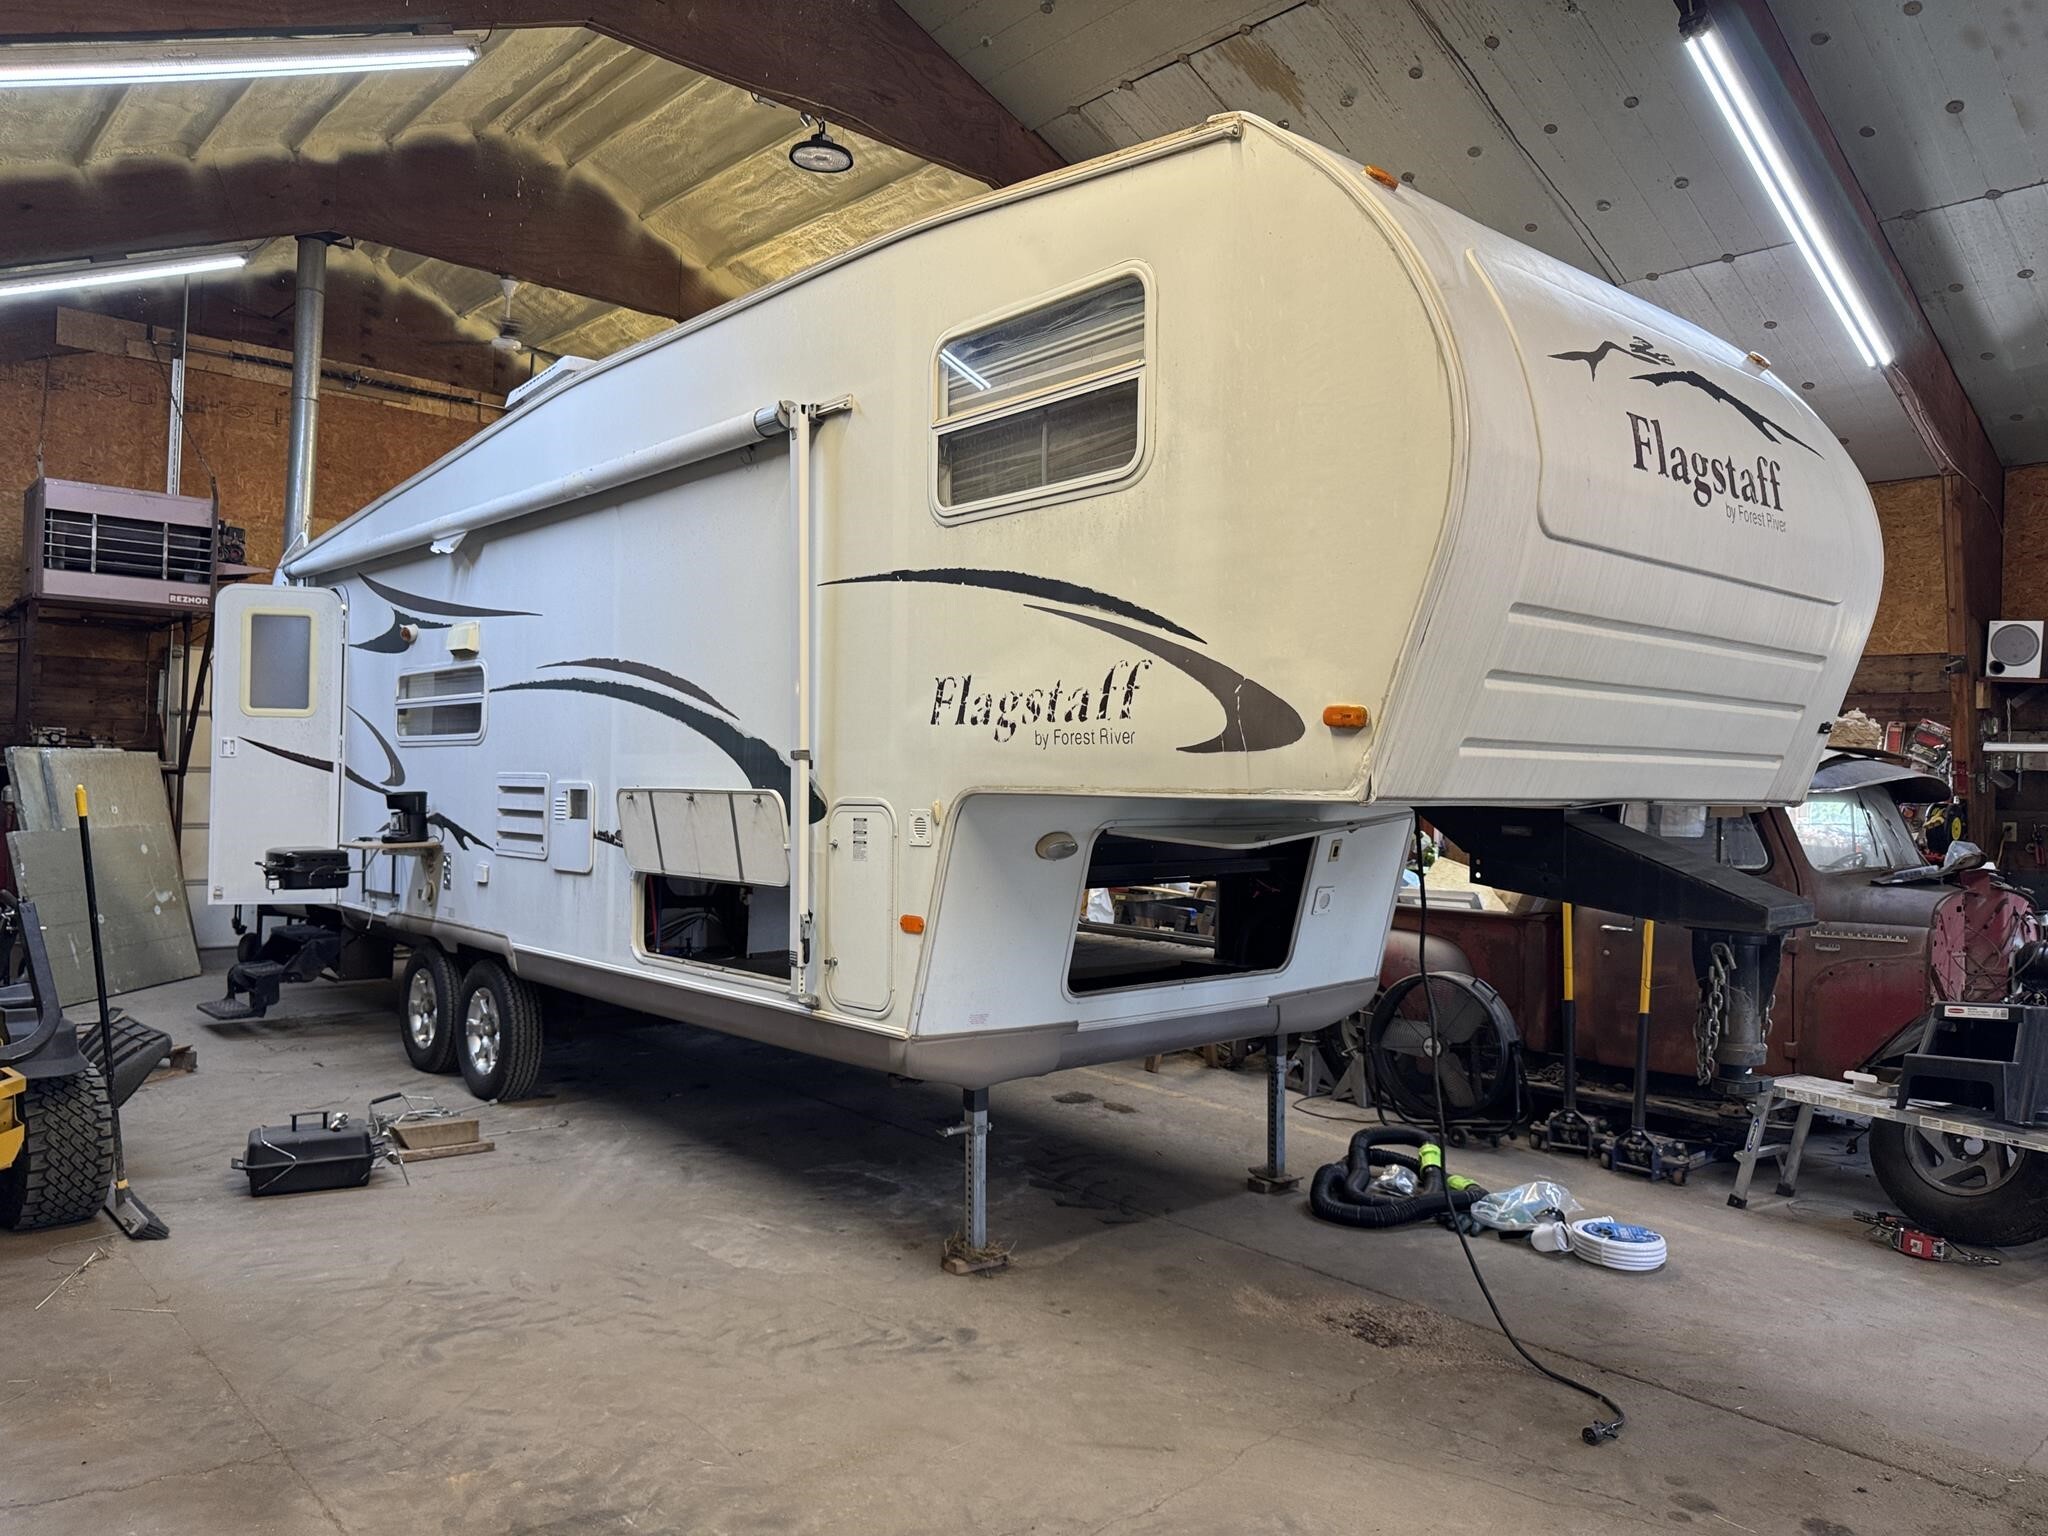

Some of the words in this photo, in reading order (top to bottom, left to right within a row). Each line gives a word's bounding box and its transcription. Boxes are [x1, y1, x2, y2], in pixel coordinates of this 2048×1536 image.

[1626, 411, 1784, 512] Flagstaff
[1725, 503, 1737, 524] by
[1738, 505, 1765, 527] Forest
[1766, 512, 1787, 533] River
[170, 594, 209, 605] REZNOR
[930, 660, 1153, 743] Flagstaff
[1034, 730, 1049, 750] by
[1053, 728, 1096, 745] Forest
[1099, 728, 1136, 745] River
